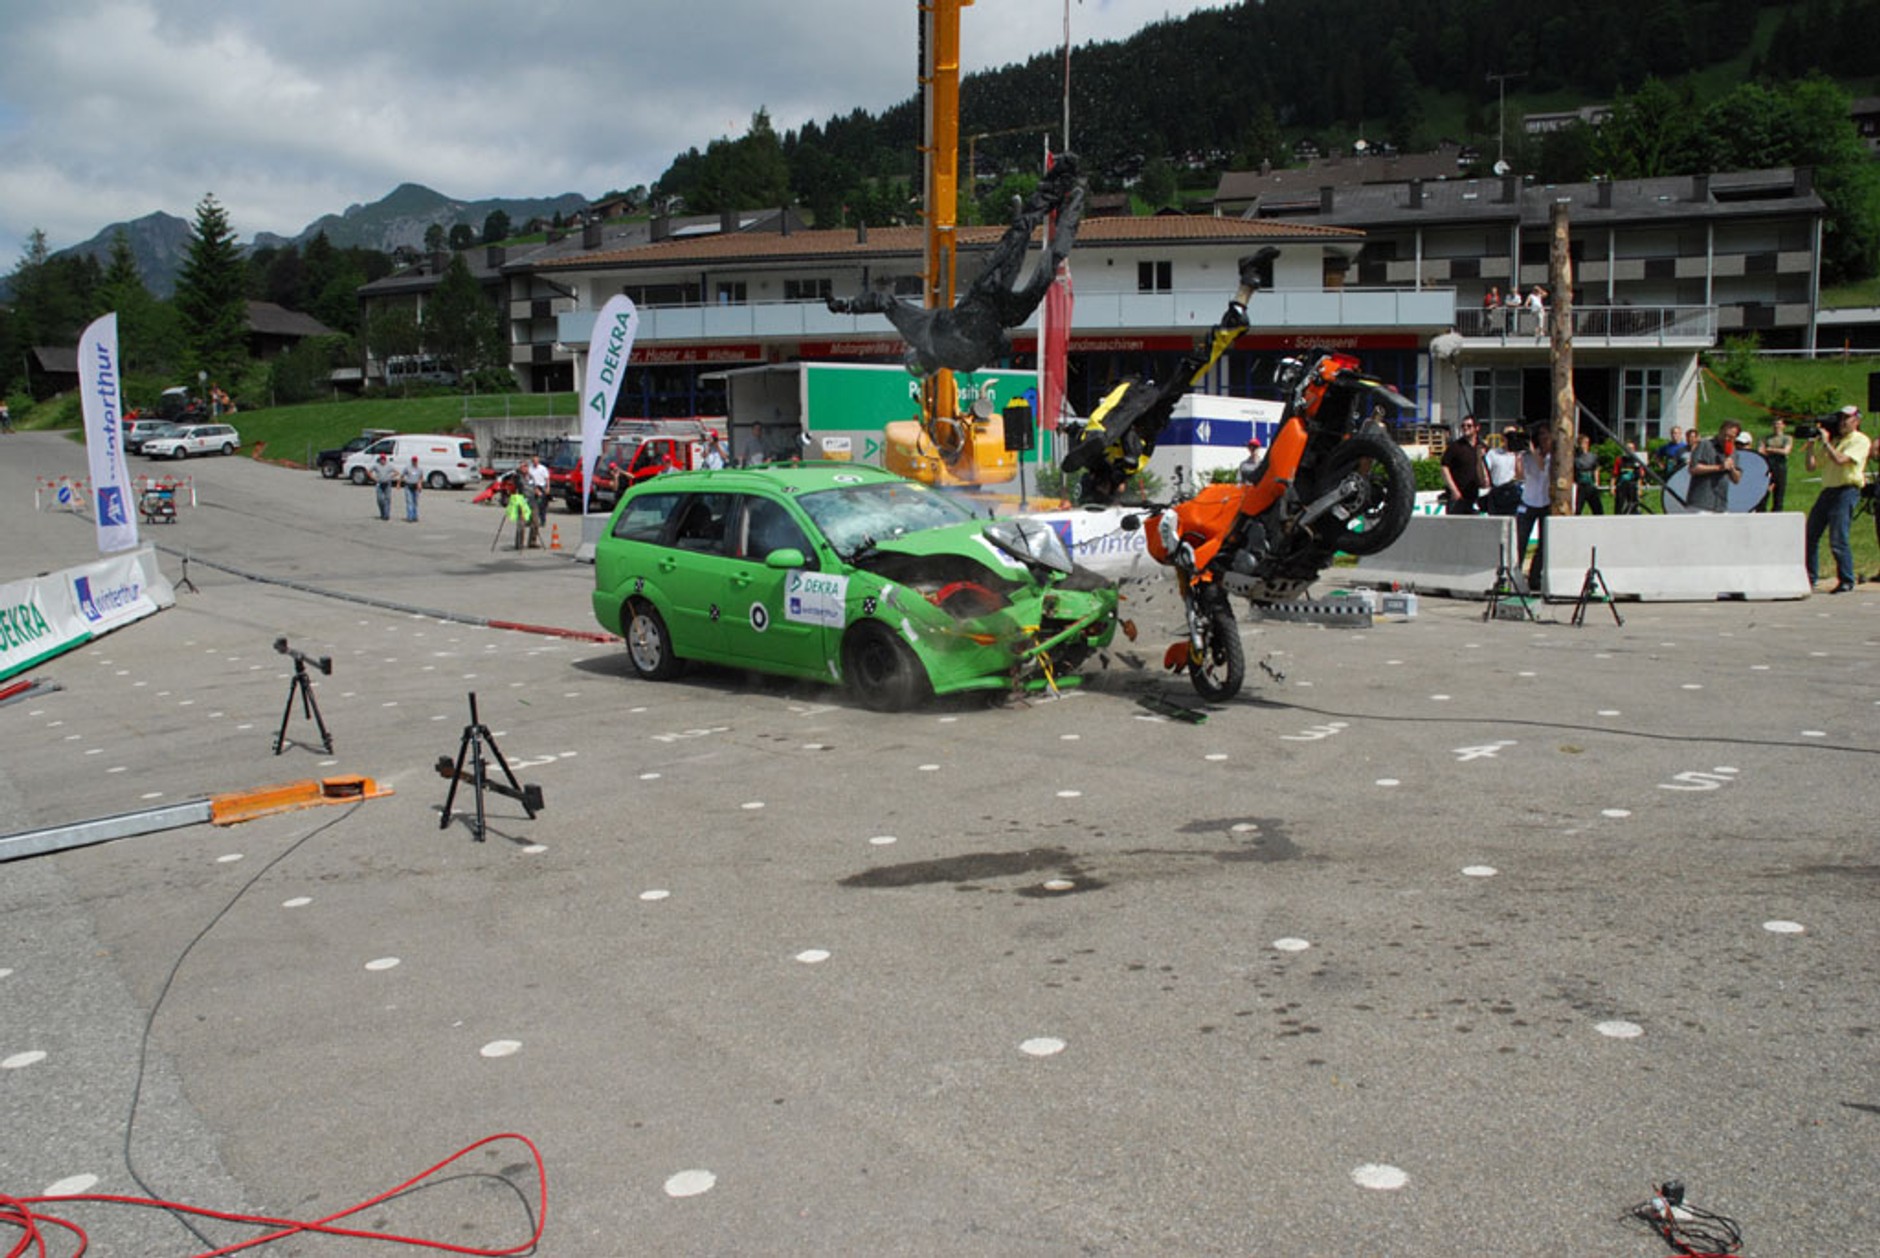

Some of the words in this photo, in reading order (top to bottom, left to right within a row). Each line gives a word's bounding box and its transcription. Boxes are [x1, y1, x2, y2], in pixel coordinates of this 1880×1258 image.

[600, 312, 630, 385] DEKRA
[1069, 337, 1144, 350] andmaschinen
[804, 578, 839, 595] DEKRA
